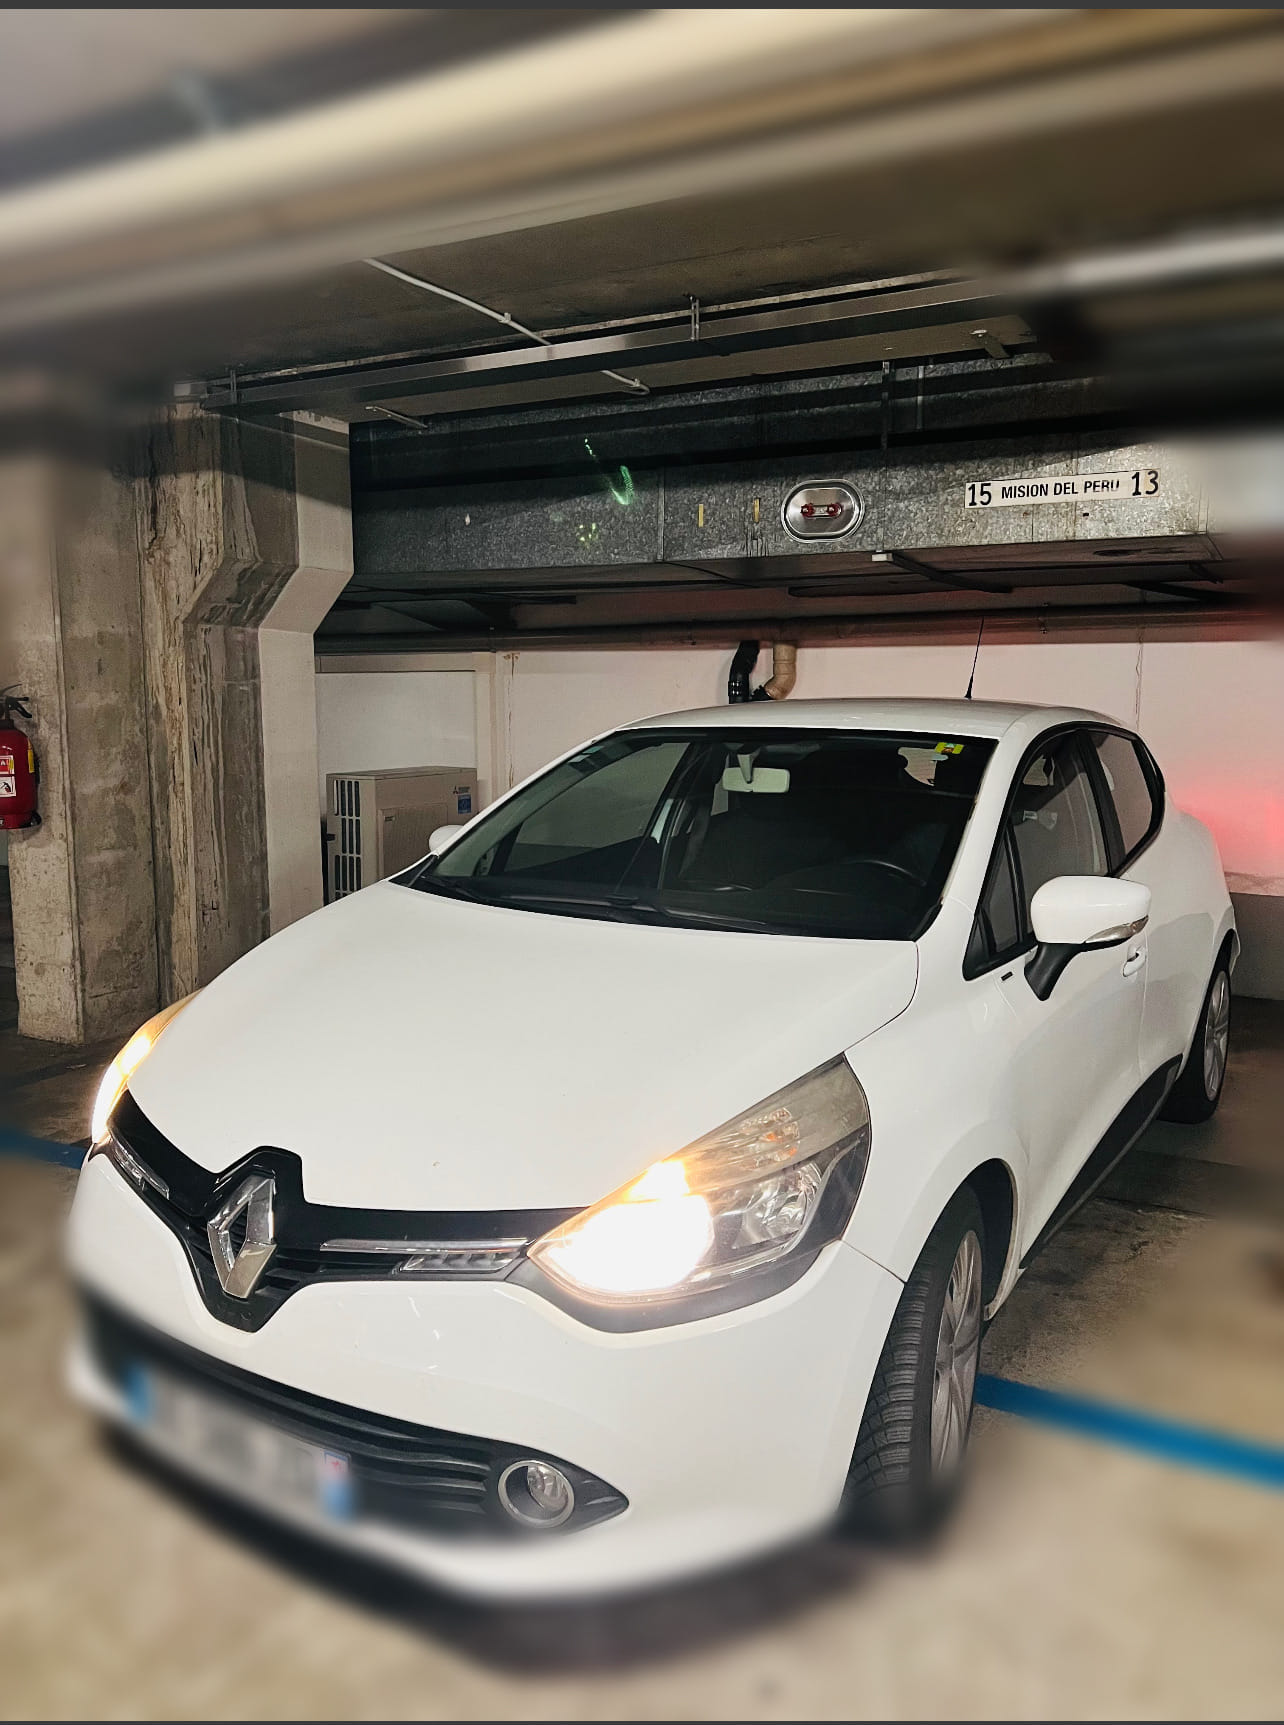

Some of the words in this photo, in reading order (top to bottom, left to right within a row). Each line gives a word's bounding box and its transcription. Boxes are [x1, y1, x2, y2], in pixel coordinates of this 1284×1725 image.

[967, 483, 992, 506] 15
[1001, 483, 1048, 499] MISION
[1053, 481, 1078, 496] DEL
[1131, 470, 1159, 496] 13
